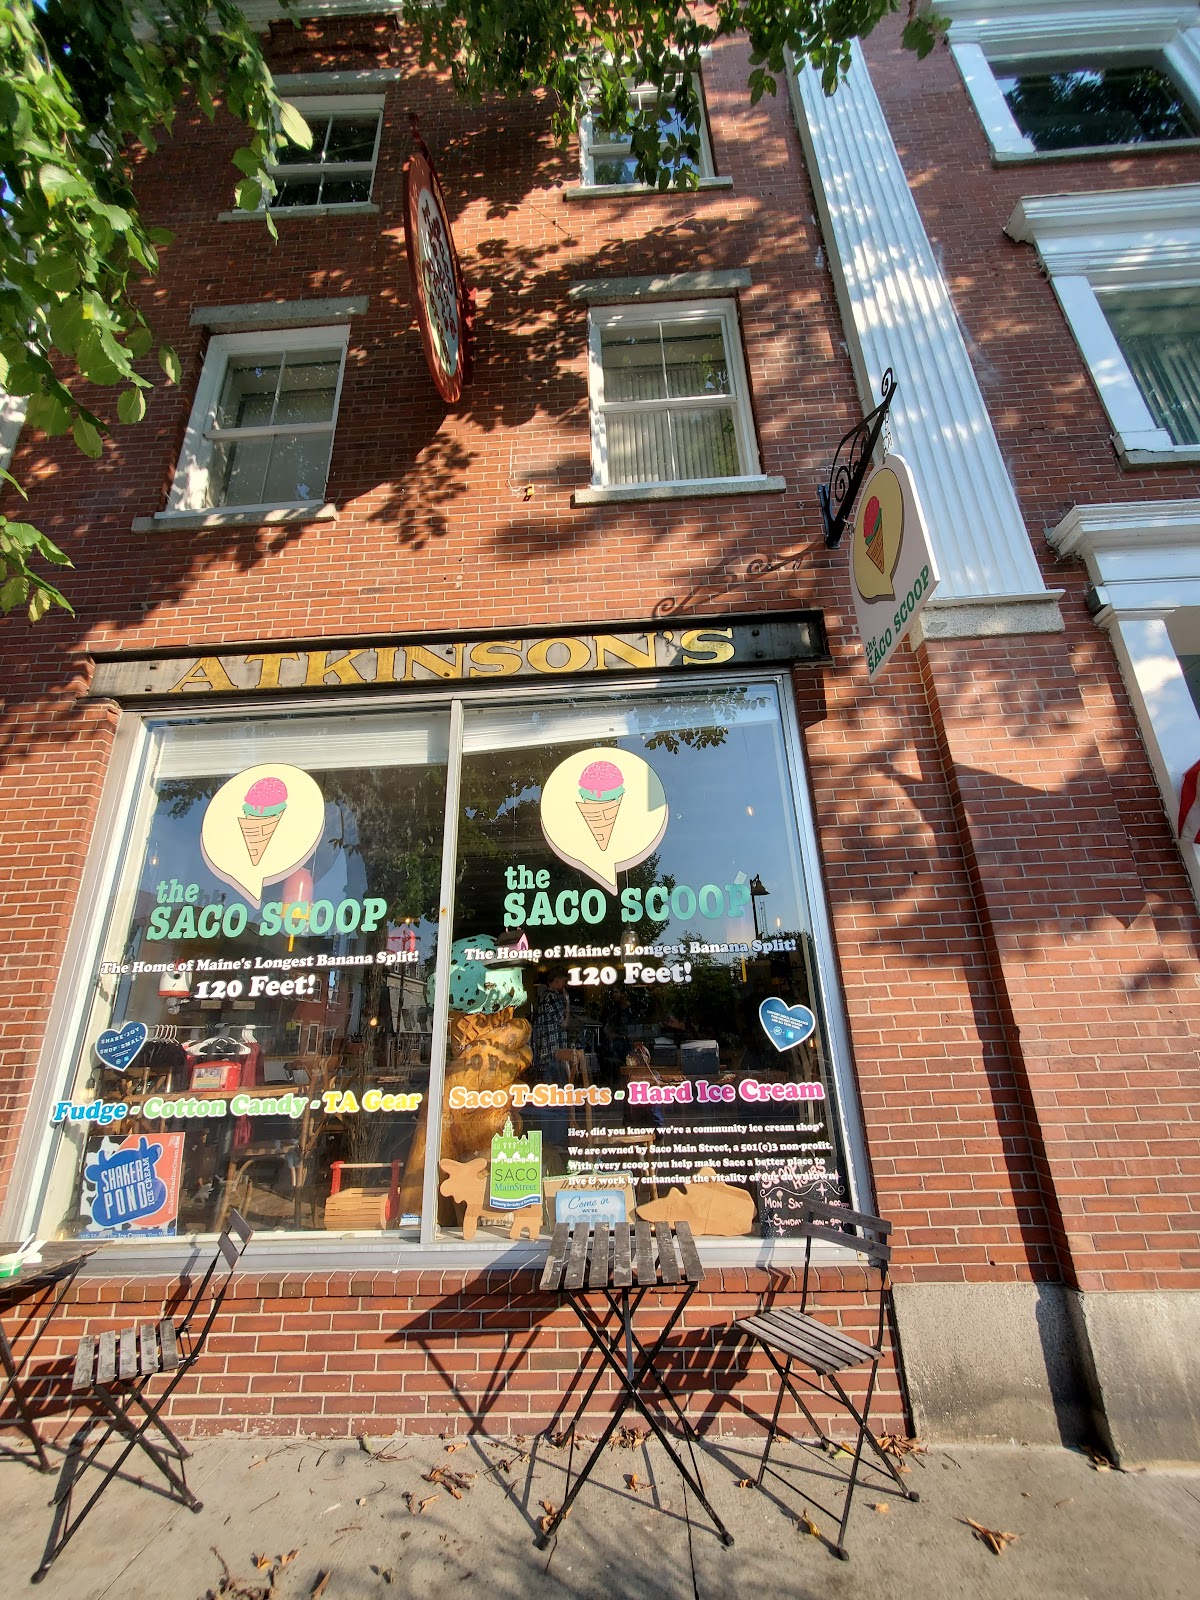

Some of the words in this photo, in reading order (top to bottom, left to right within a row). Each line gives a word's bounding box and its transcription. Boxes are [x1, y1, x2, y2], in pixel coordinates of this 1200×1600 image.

[868, 626, 893, 676] SACO
[893, 564, 930, 635] SCOOP
[865, 636, 877, 656] the
[168, 627, 735, 693] ATKINSON'S
[504, 864, 550, 891] the
[156, 879, 199, 903] the
[503, 888, 607, 927] SACO
[620, 884, 750, 923] SCOOP
[146, 902, 248, 941] SACO
[259, 897, 388, 937] SCOOP
[464, 948, 494, 961] The
[497, 946, 541, 960] Home
[544, 945, 560, 959] of
[563, 943, 622, 959] Maine's
[624, 942, 688, 959] Longest
[690, 940, 749, 954] Banana
[752, 938, 797, 954] Split!
[101, 962, 129, 974] The
[133, 961, 174, 974] Home
[177, 959, 195, 972] of
[196, 957, 251, 971] Maine's
[254, 955, 315, 971] Longest
[317, 953, 373, 967] Banana
[376, 951, 419, 966] Split!
[567, 966, 617, 986] 120
[623, 962, 692, 985] Feet!
[194, 981, 243, 999] 120
[248, 974, 316, 997] Feet!
[450, 1086, 507, 1110] Saco
[509, 1083, 612, 1108] T-Shirts
[627, 1081, 693, 1105] Hard
[695, 1080, 735, 1103] Ice
[738, 1078, 825, 1103] Cream
[52, 1099, 128, 1125] Fudge
[144, 1097, 231, 1119] Cotton
[230, 1093, 308, 1118] Candy
[322, 1091, 359, 1113] TA
[361, 1089, 423, 1112] Gear
[567, 1128, 589, 1138] Hey,
[590, 1127, 606, 1136] did
[608, 1128, 626, 1137] you
[626, 1126, 655, 1135] know
[657, 1125, 684, 1134] we're
[693, 1124, 747, 1134] community
[749, 1124, 763, 1132] ice
[796, 1122, 824, 1132] shop?
[567, 1146, 583, 1155] We
[602, 1146, 635, 1154] owned
[636, 1145, 648, 1155] by
[649, 1144, 671, 1153] Saco
[673, 1144, 697, 1153] Main
[698, 1144, 732, 1153] Street,
[741, 1142, 778, 1153] 501(c)3
[101, 1159, 144, 1192] SHAKER
[142, 1157, 153, 1189] CREAM
[495, 1168, 537, 1182] SACO
[568, 1160, 592, 1171] With
[594, 1162, 621, 1171] every
[622, 1161, 649, 1169] scoop
[651, 1161, 670, 1169] you
[671, 1159, 693, 1169] help
[694, 1159, 722, 1167] make
[723, 1158, 745, 1167] Saco
[754, 1158, 785, 1166] better
[787, 1157, 813, 1167] place
[815, 1157, 825, 1165] to
[494, 1183, 537, 1192] MainStreet
[569, 1177, 587, 1185] live
[599, 1176, 626, 1185] work
[628, 1175, 639, 1185] by
[641, 1174, 691, 1184] enhancing
[692, 1174, 709, 1182] the
[711, 1173, 747, 1183] vitality
[749, 1173, 760, 1181] of
[104, 1181, 148, 1220] POND
[147, 1189, 155, 1206] ICE
[568, 1196, 597, 1210] Come
